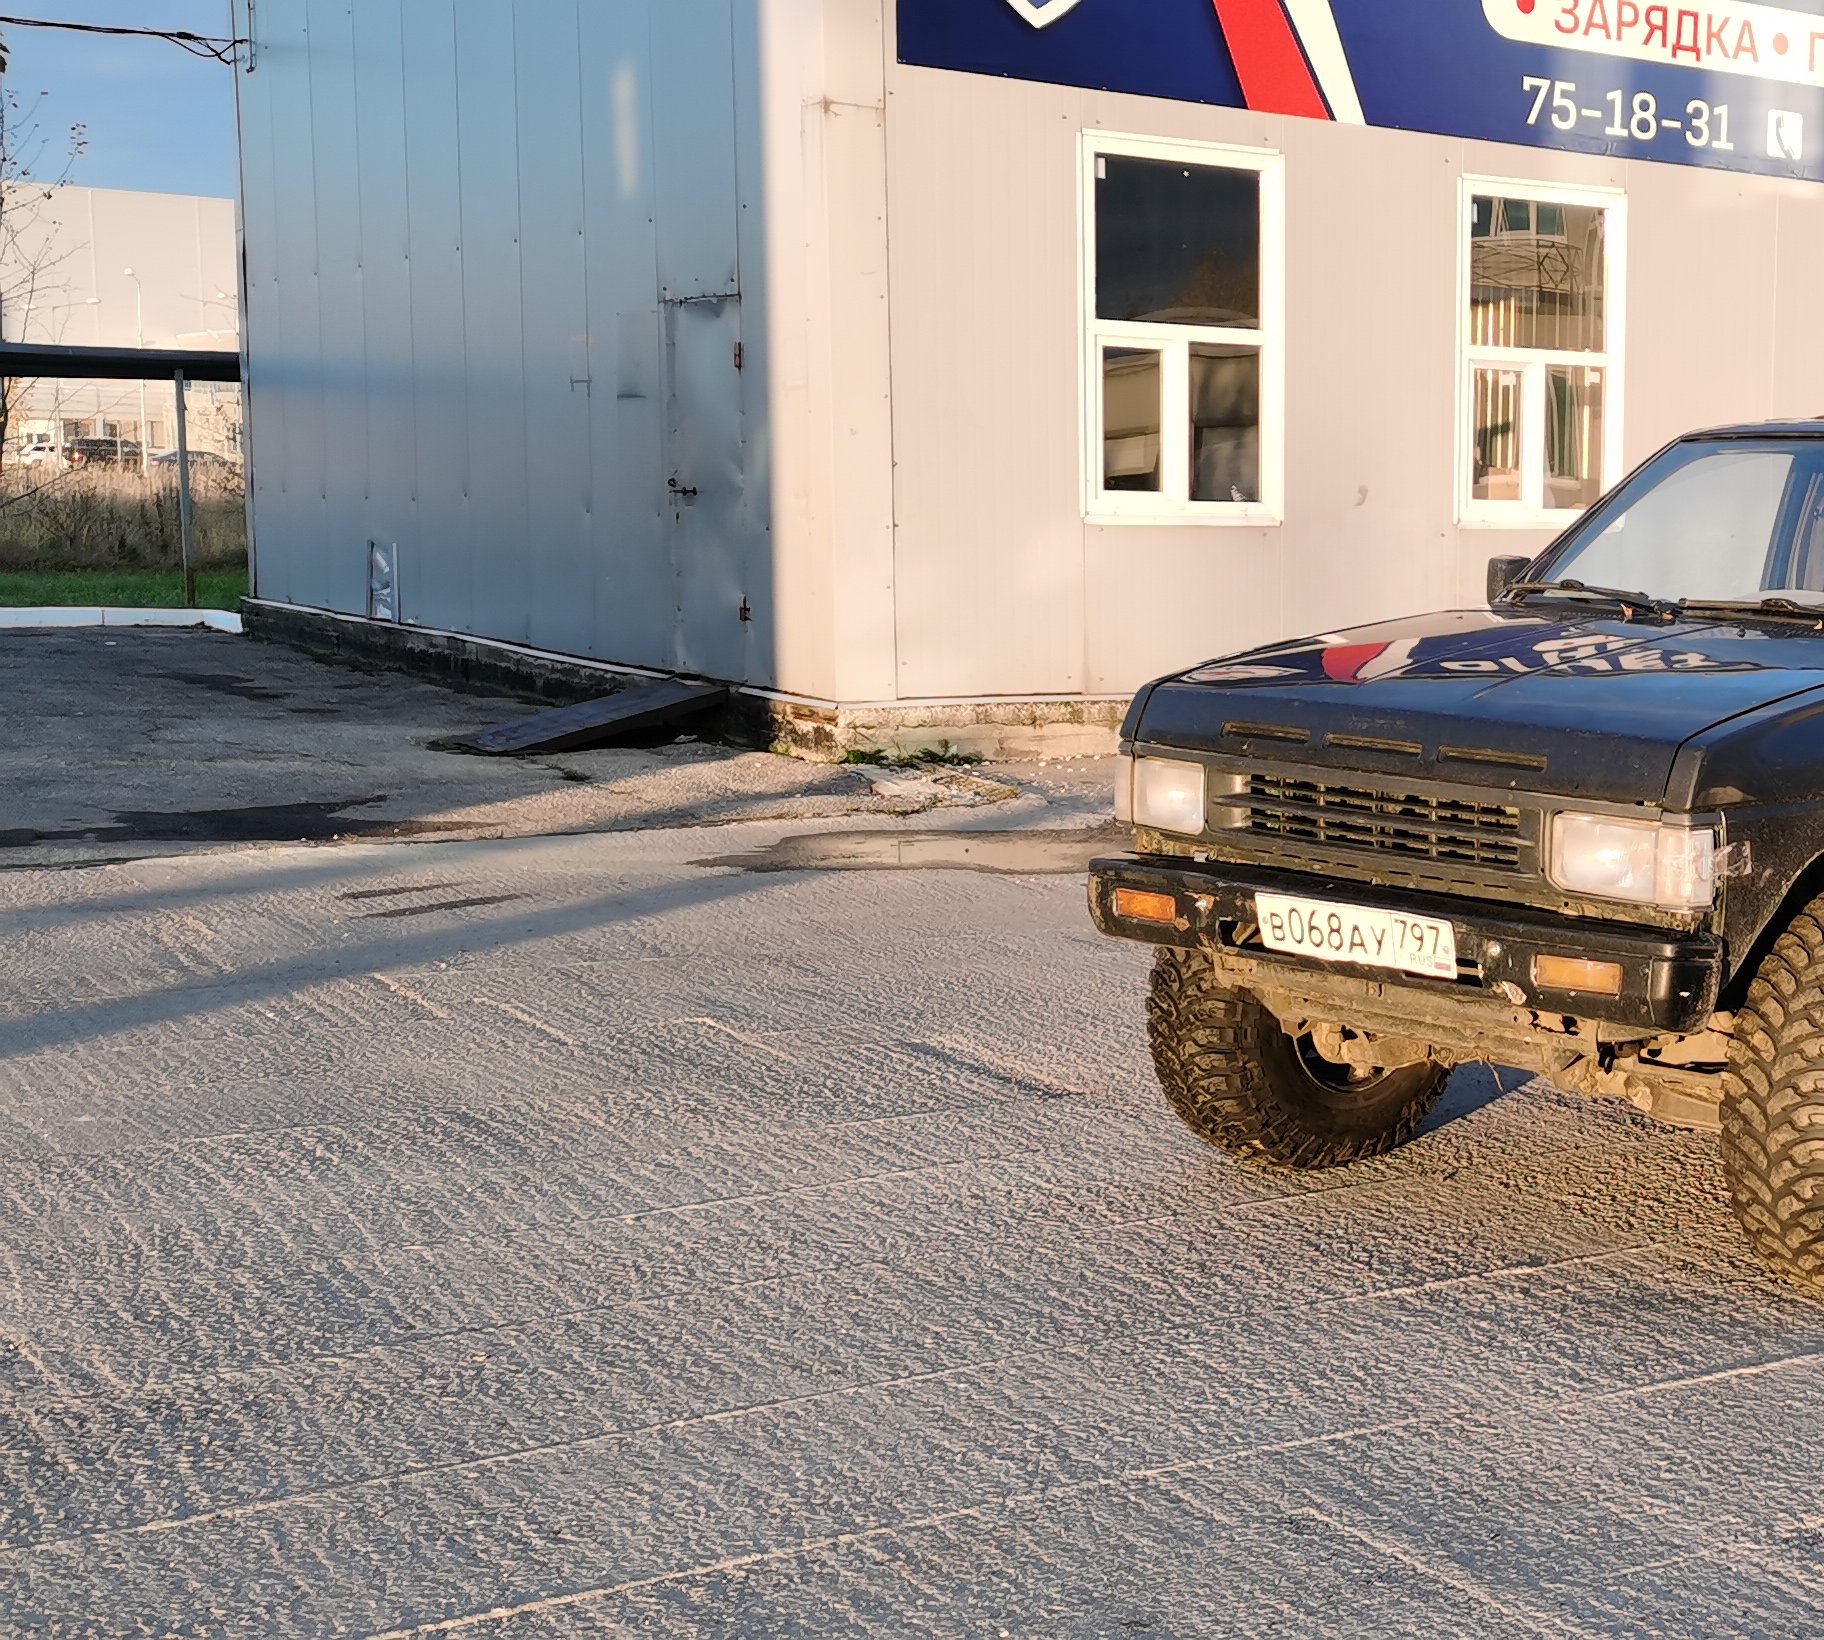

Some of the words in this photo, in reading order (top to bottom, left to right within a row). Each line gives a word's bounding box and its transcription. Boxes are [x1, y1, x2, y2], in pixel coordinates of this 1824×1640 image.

[1554, 0, 1760, 62] ЗАРЯДКА
[1521, 74, 1735, 151] 75-18-31
[1393, 918, 1440, 956] 797
[1409, 953, 1434, 968] RUS
